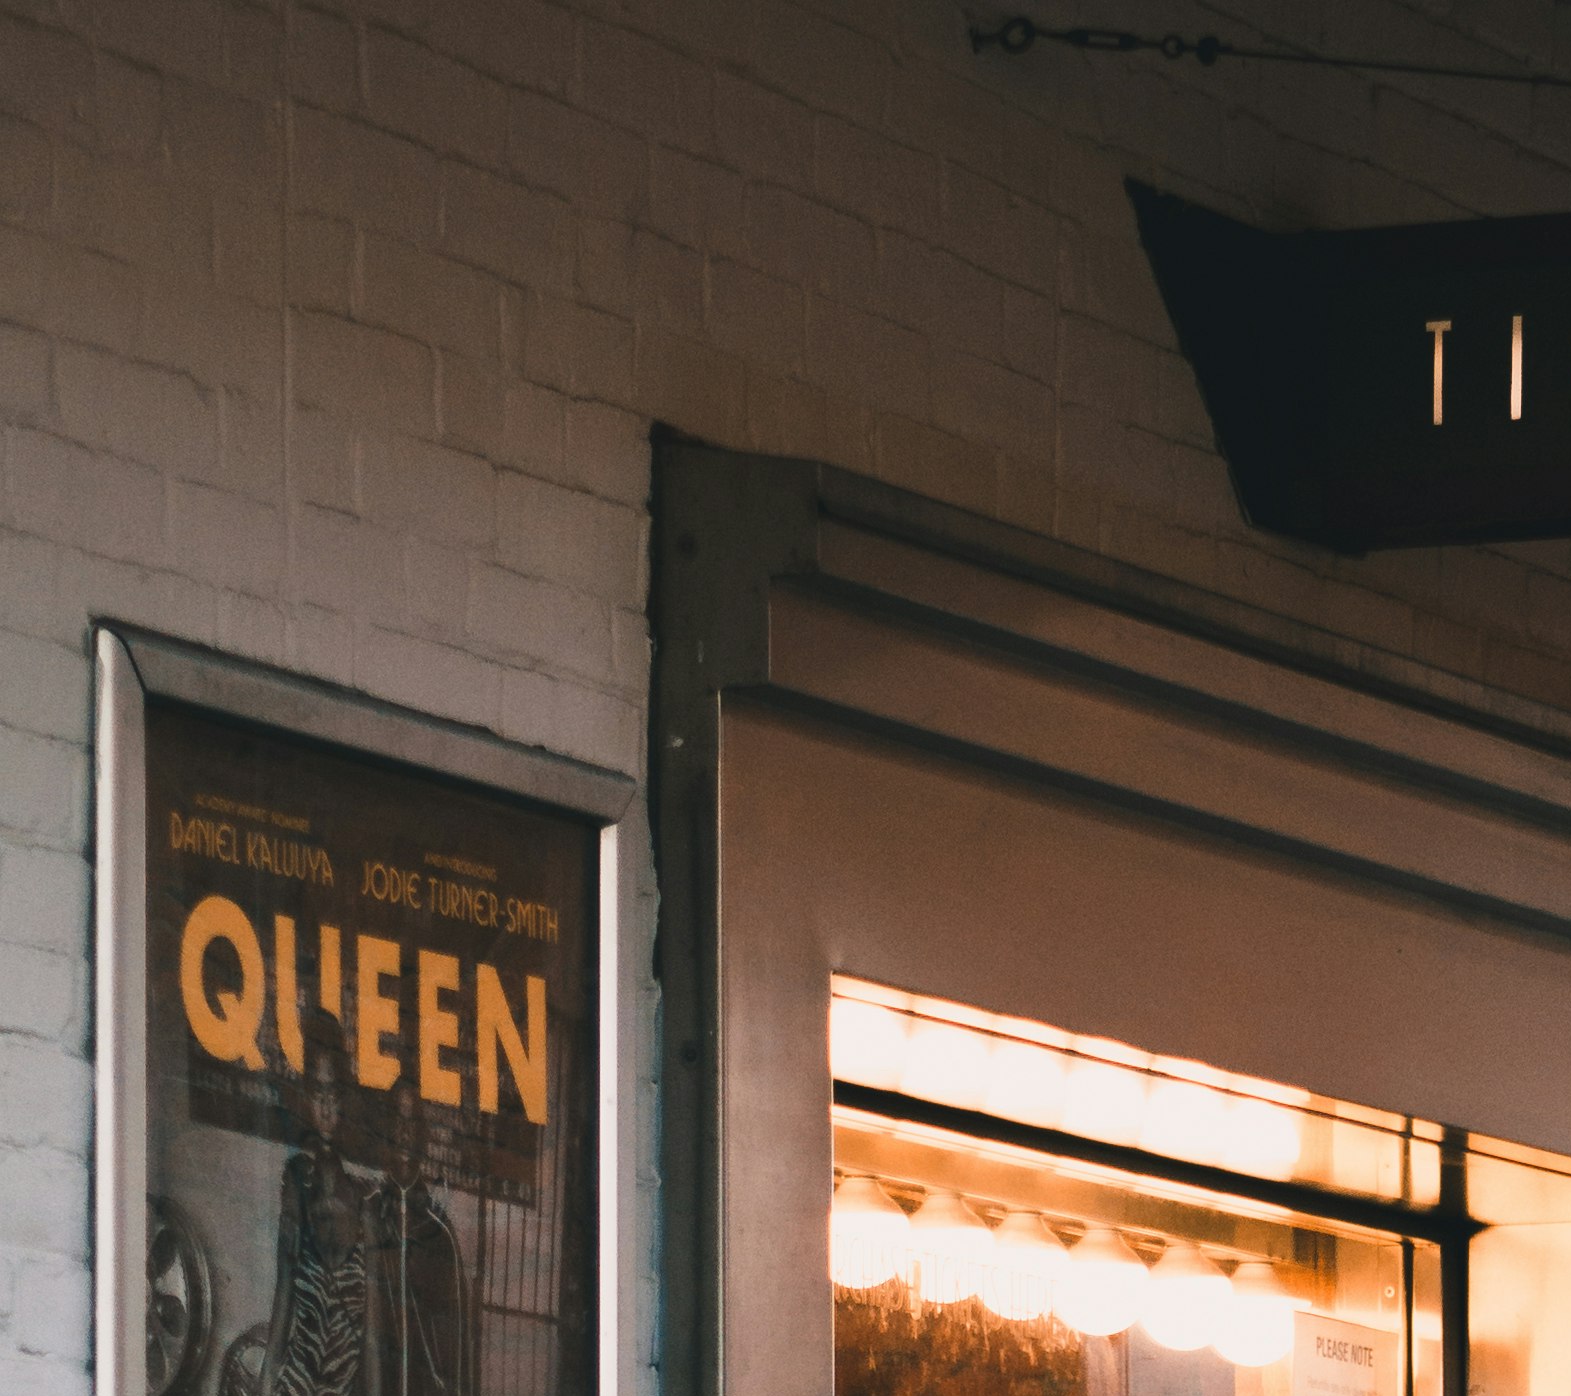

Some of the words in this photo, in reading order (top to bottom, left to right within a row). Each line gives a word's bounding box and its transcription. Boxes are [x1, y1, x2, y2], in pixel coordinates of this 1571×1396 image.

[170, 811, 240, 866] DANIEL
[247, 831, 334, 888] KALUUYA
[362, 860, 422, 910] JODIE
[428, 877, 559, 945] TURNER-SMITH
[180, 895, 548, 1126] QUEEN
[1316, 1336, 1349, 1363] PLEASE
[1350, 1345, 1373, 1368] NOTE
